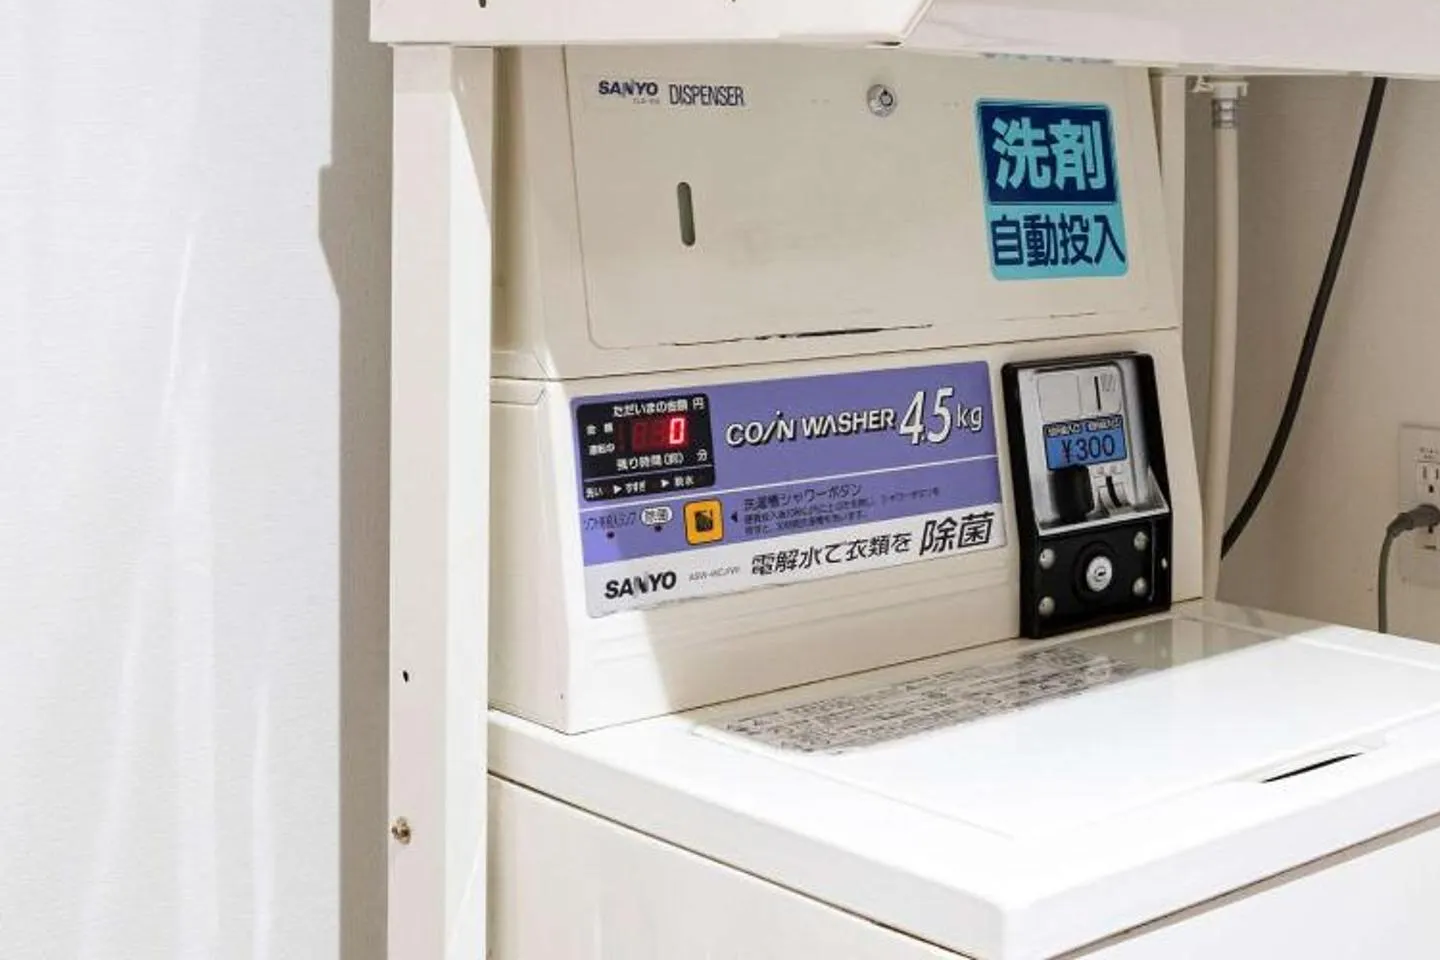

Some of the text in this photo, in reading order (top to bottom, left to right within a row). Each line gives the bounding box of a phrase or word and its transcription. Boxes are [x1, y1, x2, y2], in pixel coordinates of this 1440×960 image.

[598, 80, 659, 98] SANYO
[669, 84, 746, 107] DISPENSER
[992, 117, 1107, 190] 洗剤
[990, 213, 1126, 267] 自動投入
[668, 417, 685, 445] 0
[802, 408, 897, 438] WASHER
[1061, 434, 1116, 464] ¥300
[751, 532, 912, 576] 電解水で衣類を
[918, 511, 996, 556] 除菌
[604, 571, 677, 599] SANYO
